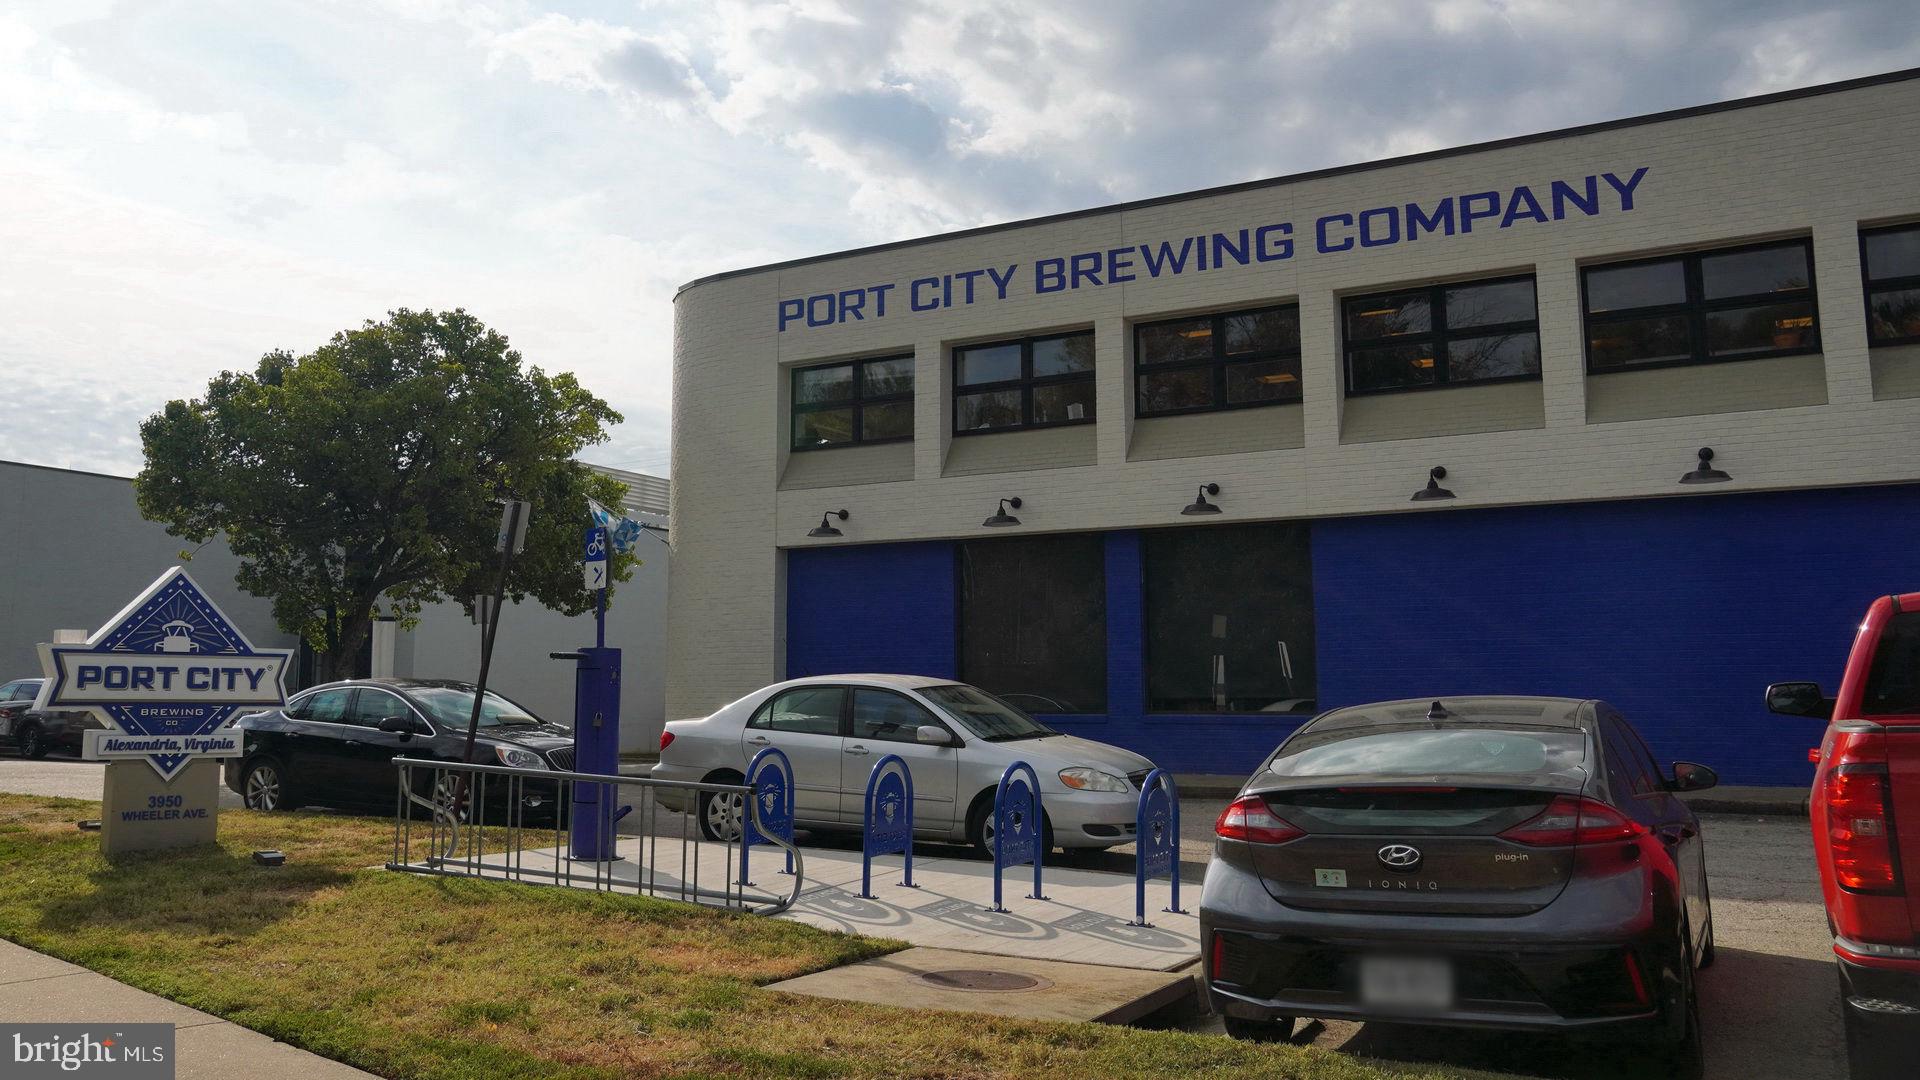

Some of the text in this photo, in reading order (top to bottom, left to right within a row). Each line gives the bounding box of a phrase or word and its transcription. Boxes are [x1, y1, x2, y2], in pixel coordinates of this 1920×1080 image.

[778, 166, 1650, 333] PORT CITY BREWING COMPANY
[77, 665, 180, 691] PORT
[186, 666, 266, 692] CITY
[140, 708, 205, 717] BREWING
[104, 738, 236, 754] Alexandria, Virginia
[148, 795, 183, 809] 3950
[122, 808, 209, 821] WHEELER AVE.
[1494, 852, 1530, 863] plug-in
[1368, 879, 1439, 891] IONIQ
